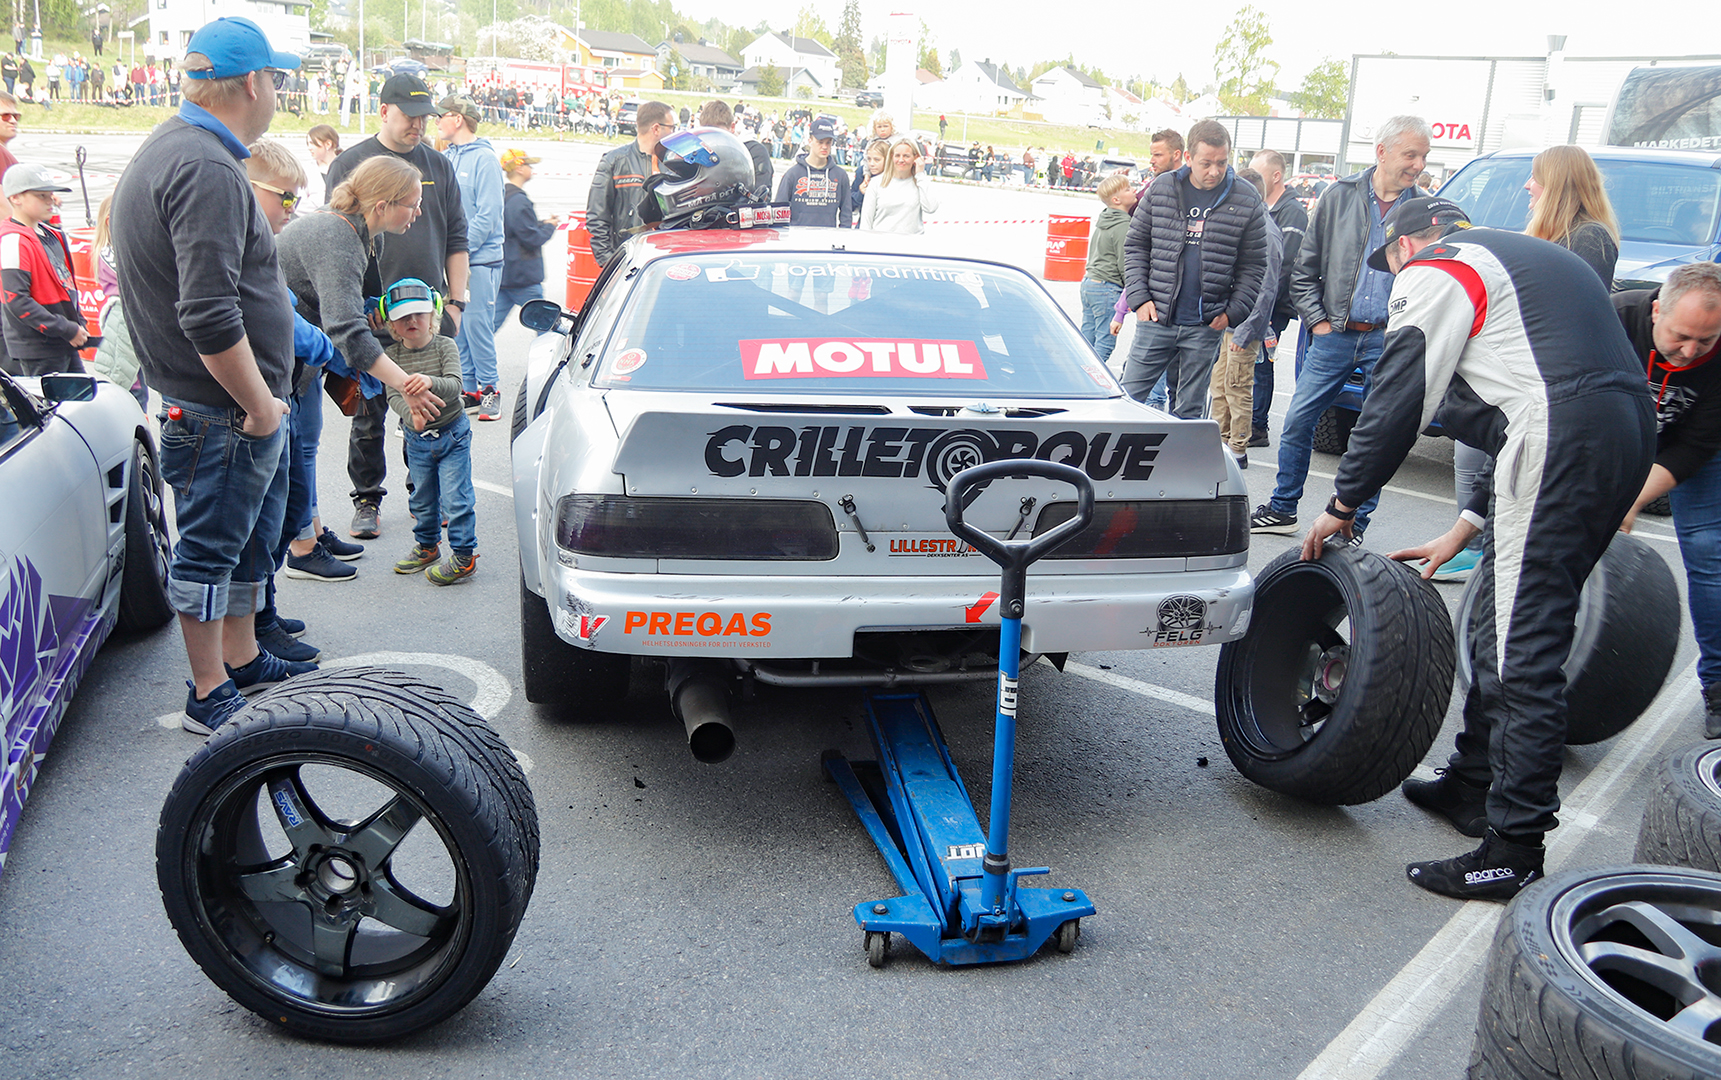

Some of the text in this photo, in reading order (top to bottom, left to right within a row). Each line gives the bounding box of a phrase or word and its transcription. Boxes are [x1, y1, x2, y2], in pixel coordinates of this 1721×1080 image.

[1431, 122, 1472, 140] OTA
[1633, 135, 1721, 149] MARKEDET
[770, 262, 982, 287] Joakimdrifting
[753, 341, 973, 374] MOTUL
[624, 611, 772, 637] PREQAS
[642, 640, 707, 648] HELHETSLØSNINGER
[1155, 630, 1203, 642] FELG
